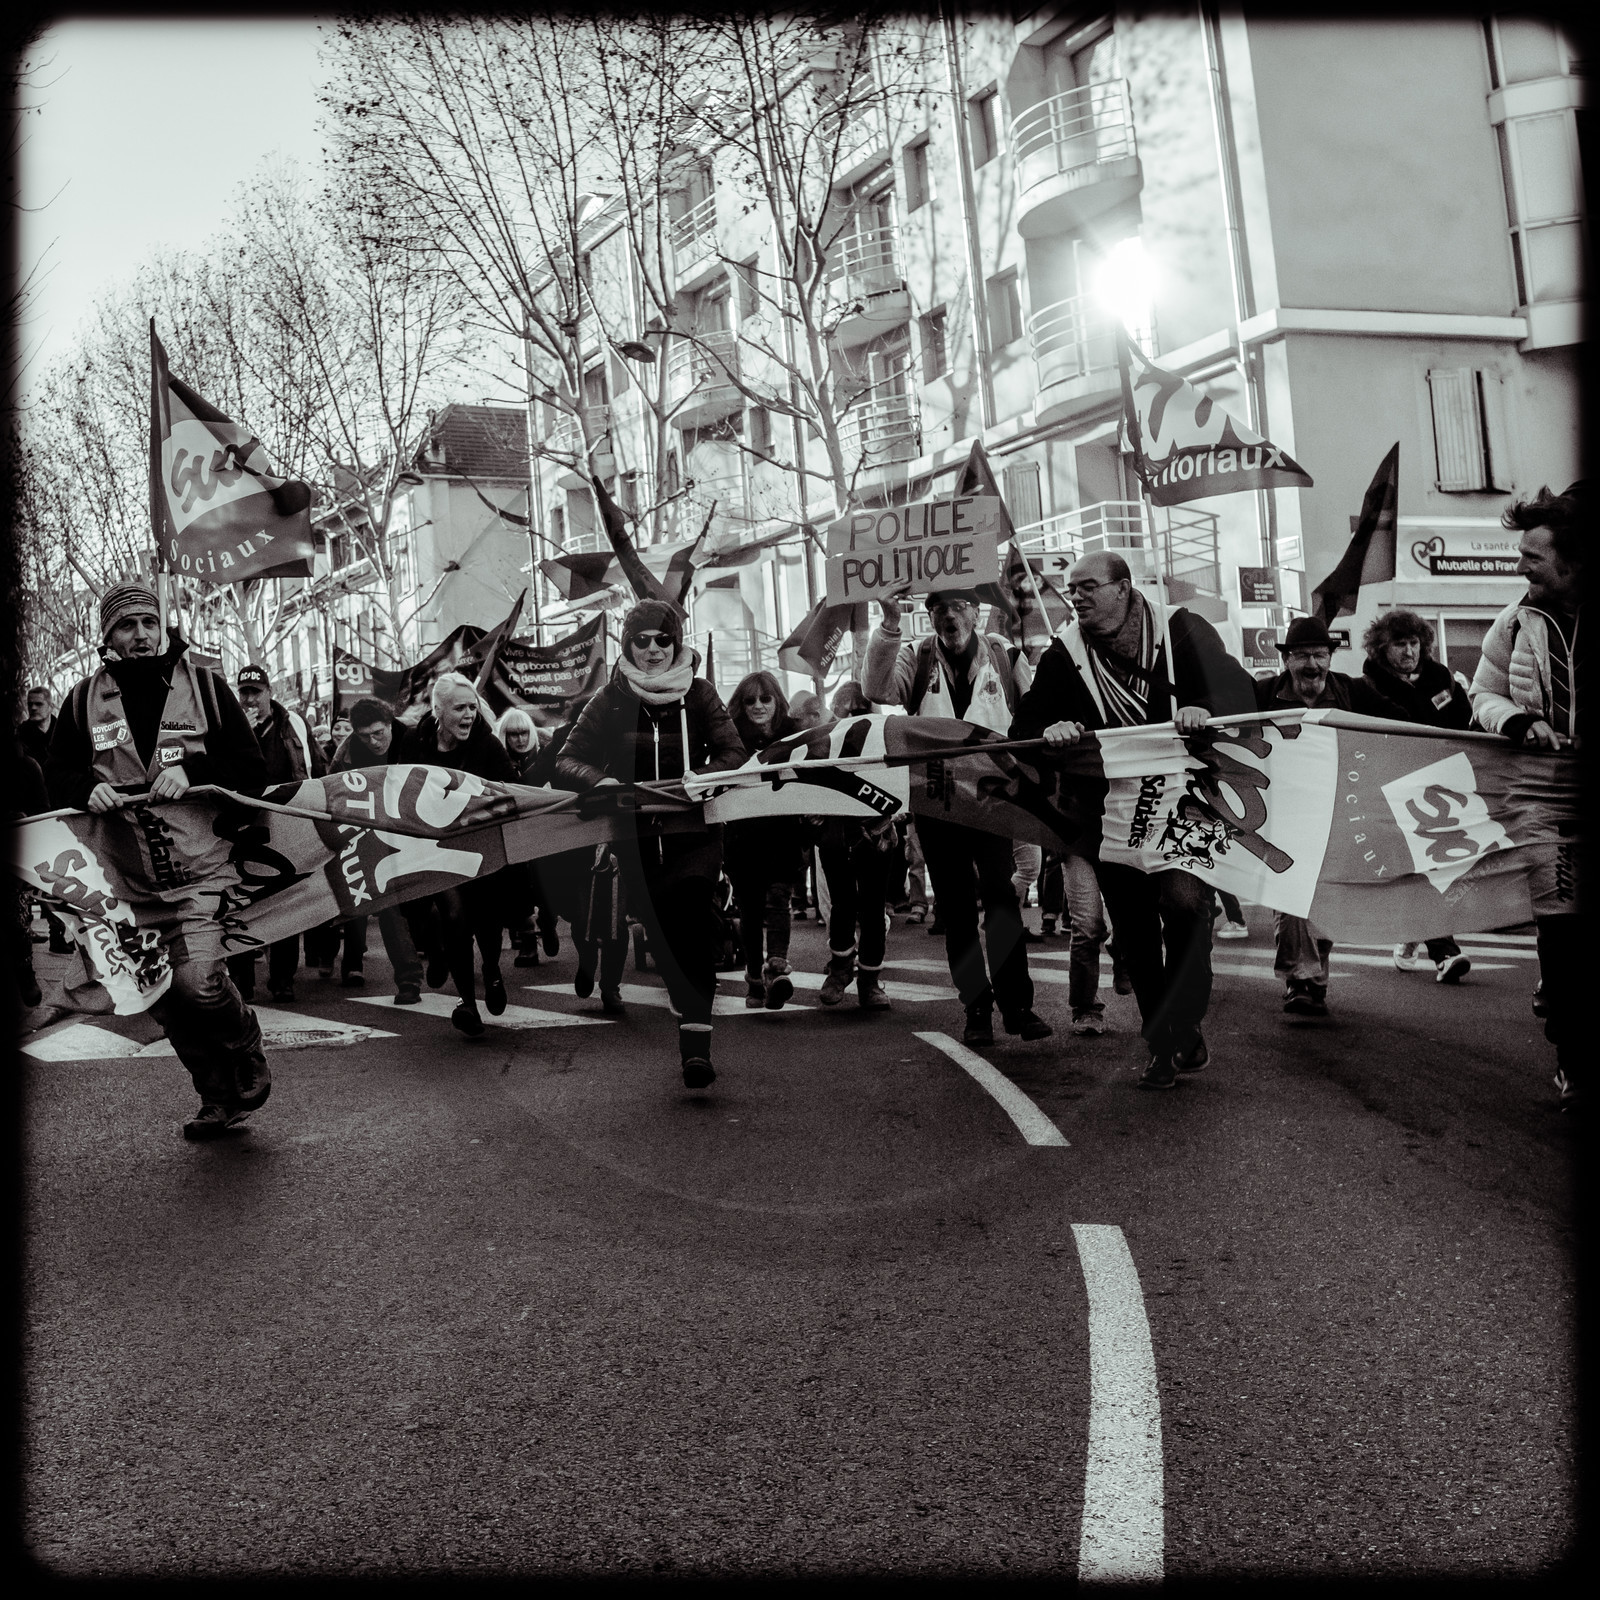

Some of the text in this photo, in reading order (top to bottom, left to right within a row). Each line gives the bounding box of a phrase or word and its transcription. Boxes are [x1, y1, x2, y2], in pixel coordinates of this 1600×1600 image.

[847, 498, 974, 552] POLICE
[1471, 542, 1481, 551] La
[1484, 542, 1509, 551] santé
[1437, 560, 1479, 572] Mutuelle
[1481, 561, 1495, 572] de
[529, 661, 560, 671] bonne
[561, 654, 587, 668] santé
[521, 672, 552, 683] devrait
[554, 671, 573, 683] pas
[160, 721, 196, 731] Solidaires
[93, 734, 105, 743] LES
[95, 740, 118, 751] ORDRES
[856, 782, 894, 812] PTT
[1346, 750, 1387, 877] sociaux
